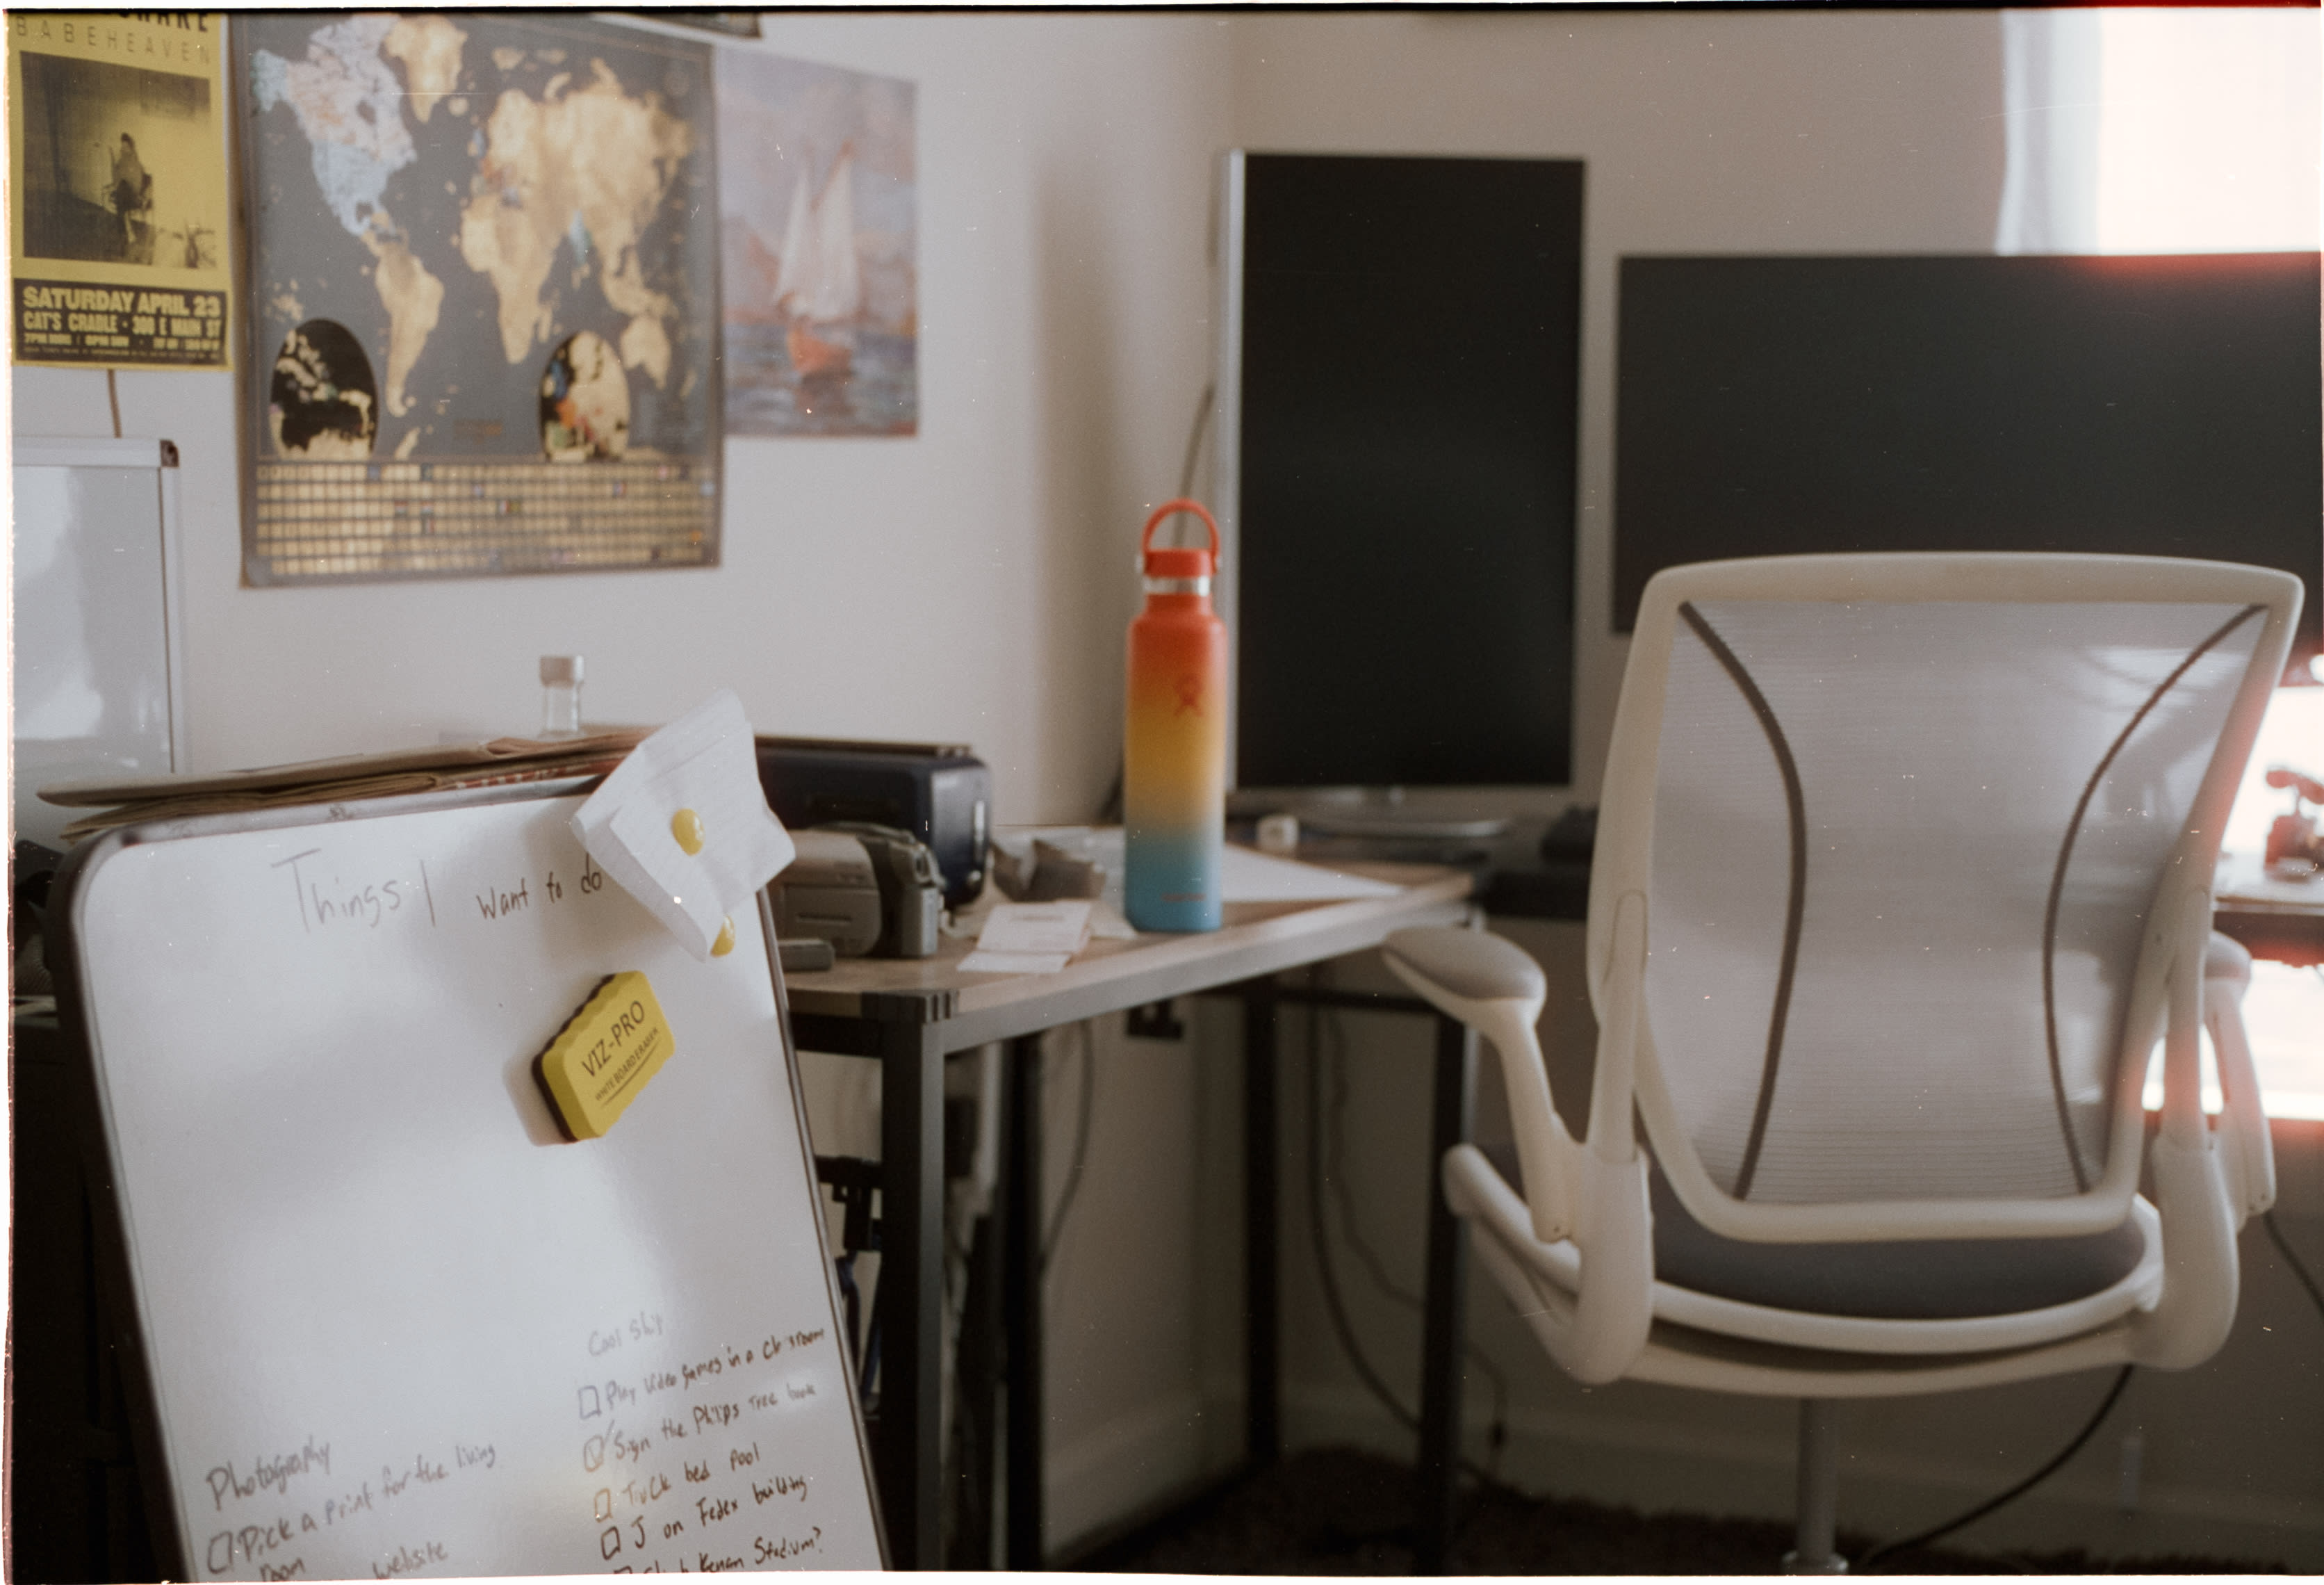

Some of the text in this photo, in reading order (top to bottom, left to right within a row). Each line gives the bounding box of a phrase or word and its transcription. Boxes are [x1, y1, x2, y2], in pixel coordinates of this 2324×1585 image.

[15, 15, 211, 64] BABEHEAVEN
[23, 286, 220, 318] SATURDAY APRIL 23
[23, 311, 61, 331] CAT'S
[270, 847, 401, 934] Things
[546, 871, 563, 904] to
[580, 852, 603, 894] do
[581, 1000, 645, 1078] VIZ-PRO
[612, 1054, 637, 1084] BOARD
[588, 1328, 623, 1356] Cool
[727, 1345, 742, 1368] in
[614, 1429, 651, 1463] Sign
[661, 1417, 688, 1440] the
[683, 1458, 711, 1484] bed
[237, 1518, 295, 1563] Pick
[415, 1454, 450, 1484] the
[455, 1443, 496, 1470] living
[663, 1520, 685, 1541] on
